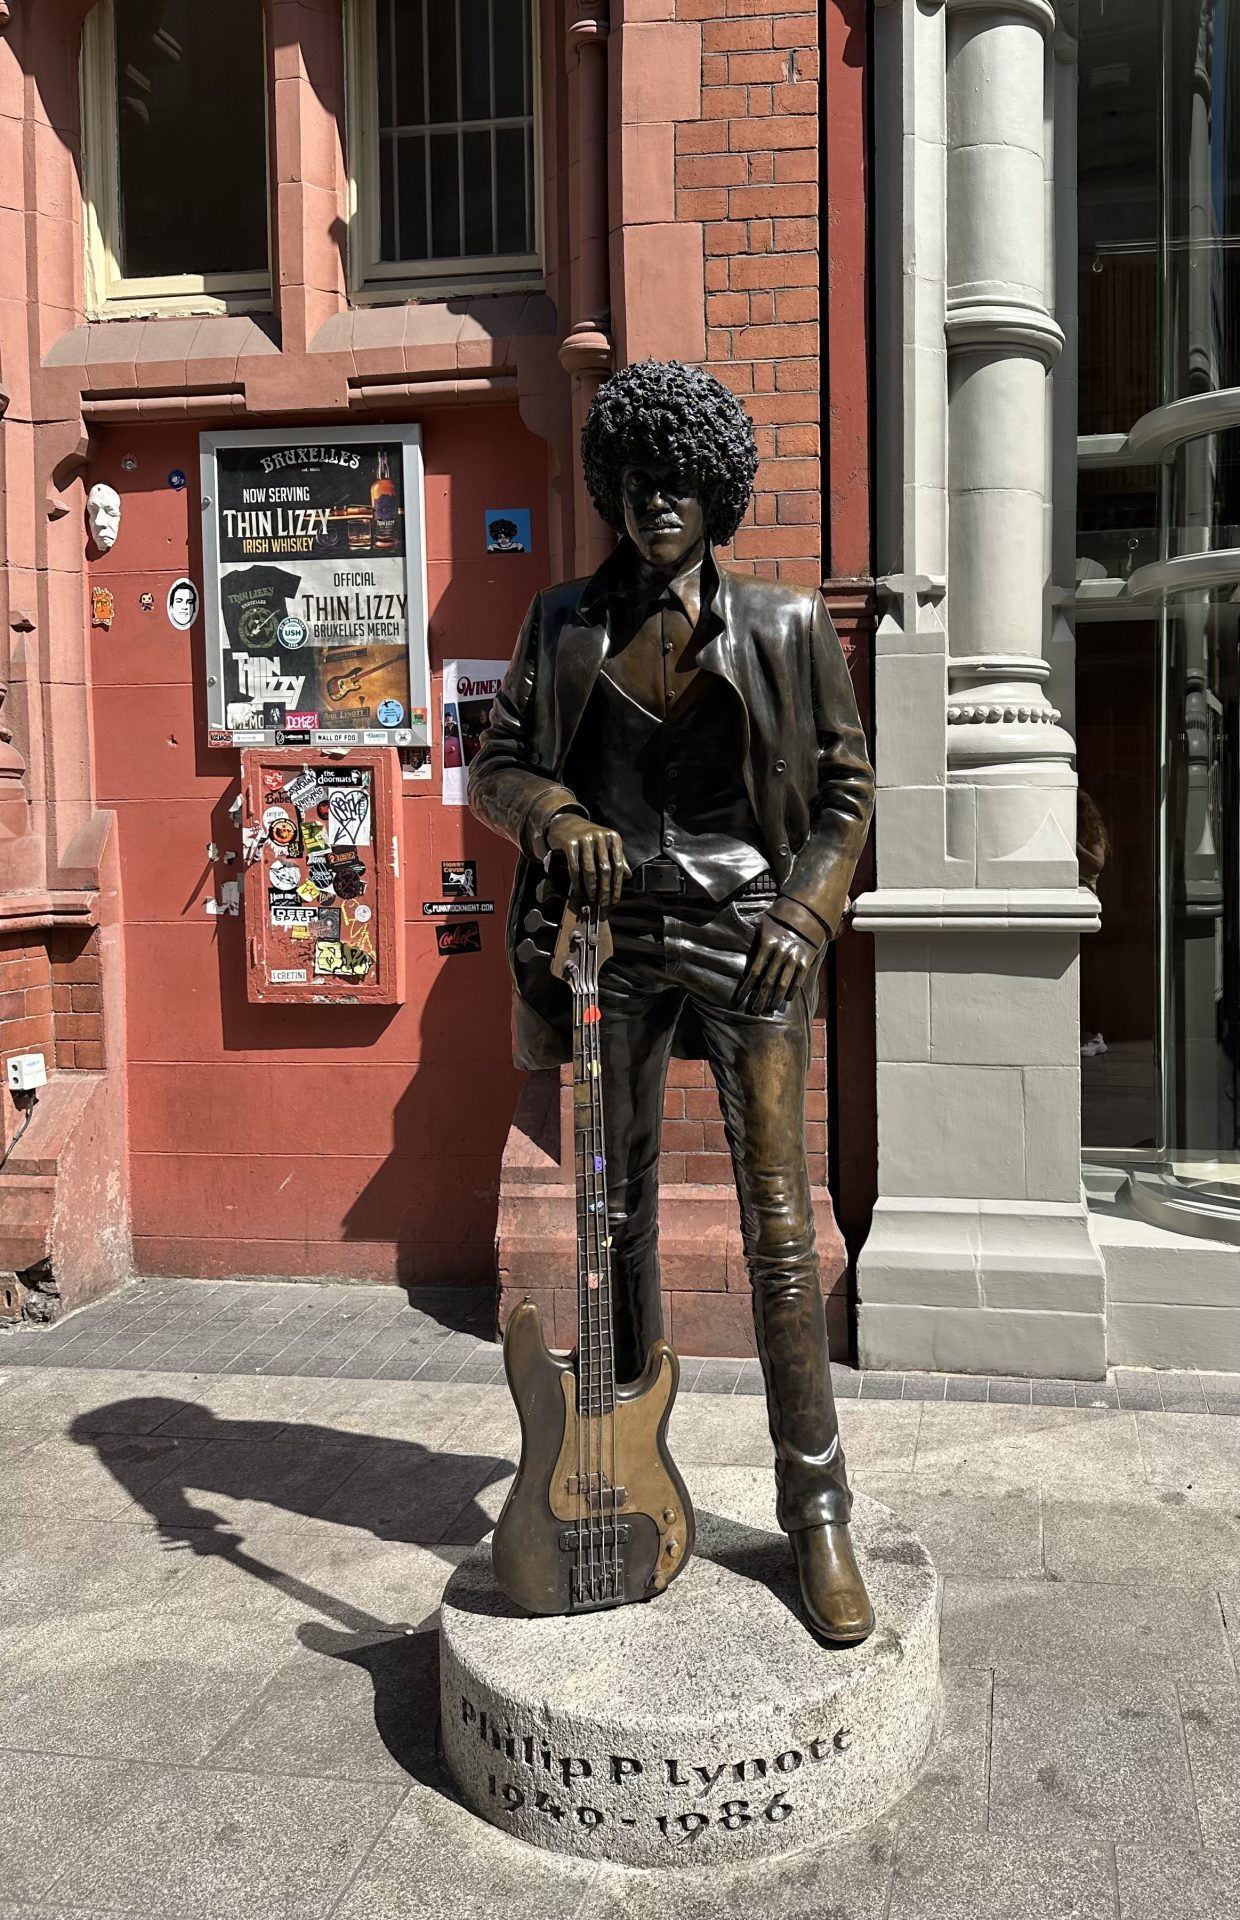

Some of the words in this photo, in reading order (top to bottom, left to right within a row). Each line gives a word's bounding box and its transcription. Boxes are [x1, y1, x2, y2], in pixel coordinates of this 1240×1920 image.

[260, 447, 360, 474] BRUXELLES
[243, 488, 267, 503] NOW
[269, 486, 310, 502] SERVING
[223, 509, 273, 538] THIN
[276, 507, 331, 536] LIZZY
[243, 539, 269, 554] IRISH
[272, 537, 314, 553] WHISKEY
[333, 572, 376, 587] OFFICIAL
[302, 594, 350, 622] THIN
[355, 592, 408, 620] LIZZY
[285, 629, 301, 637] USH
[314, 623, 365, 638] BRUXELLES
[367, 622, 400, 637] MERCH
[232, 652, 280, 698] THIN
[252, 675, 306, 711] LIZZY
[317, 773, 352, 785] doormats
[276, 909, 314, 917] DEEP
[277, 971, 306, 980] CRETINI
[609, 1755, 643, 1786] P
[664, 1727, 853, 1798] Lynott
[488, 1774, 604, 1836] 1949
[655, 1788, 794, 1848] 1986
